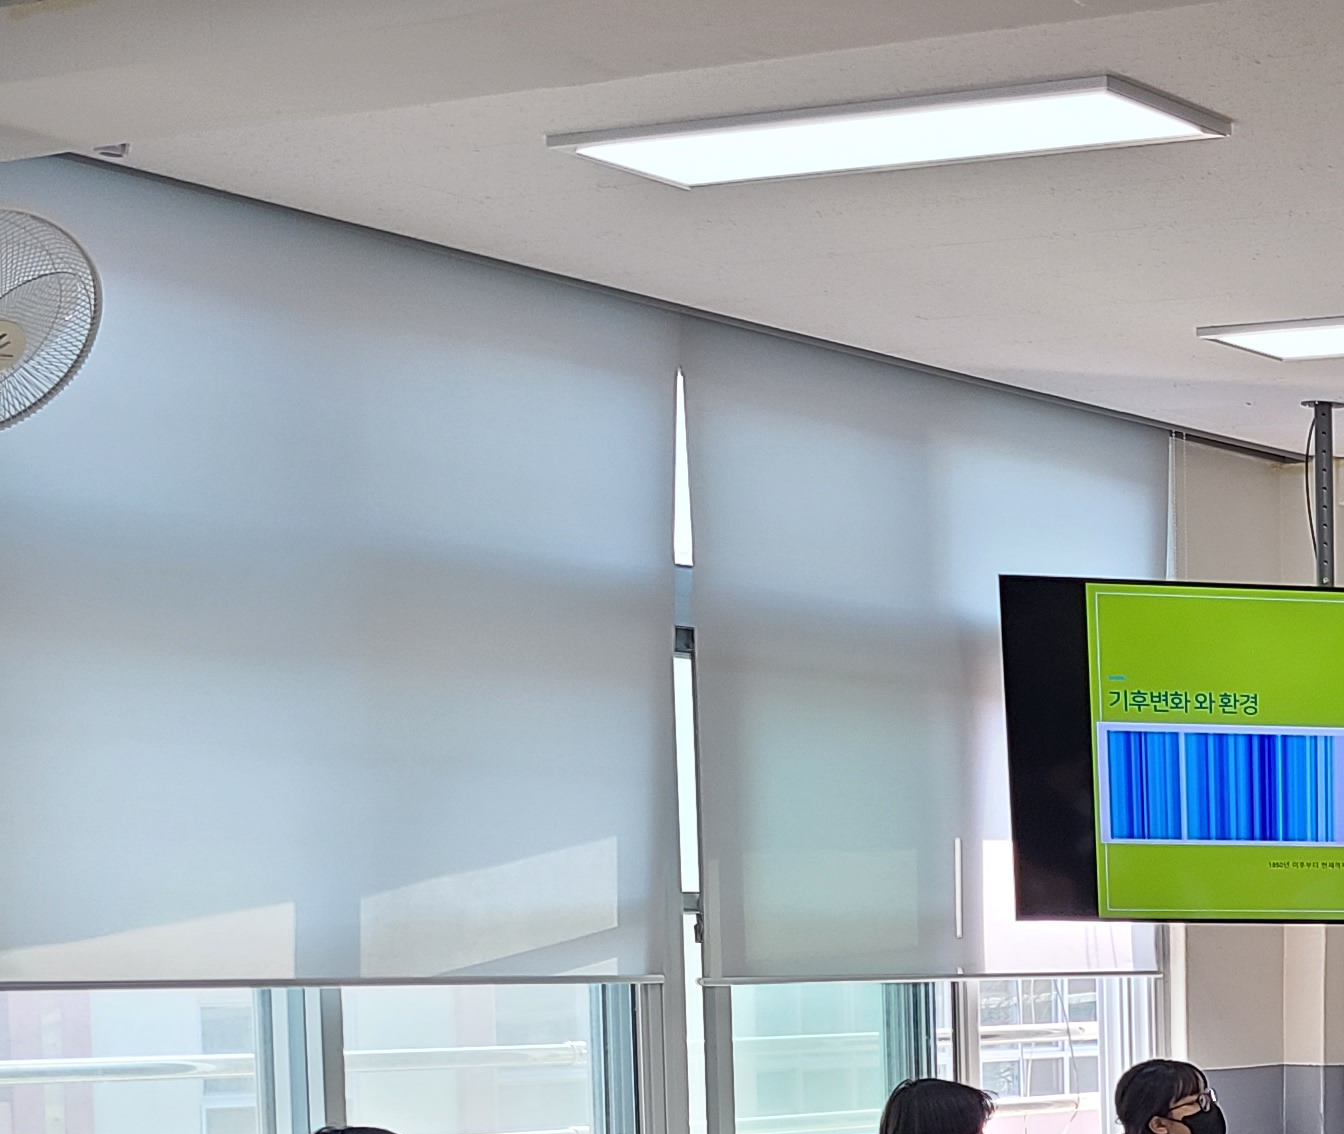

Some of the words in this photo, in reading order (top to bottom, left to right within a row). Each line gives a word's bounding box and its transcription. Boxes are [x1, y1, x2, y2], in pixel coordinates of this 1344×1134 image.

[1109, 690, 1191, 713] 기후변화
[1194, 692, 1216, 714] 와
[1219, 693, 1258, 715] 환경
